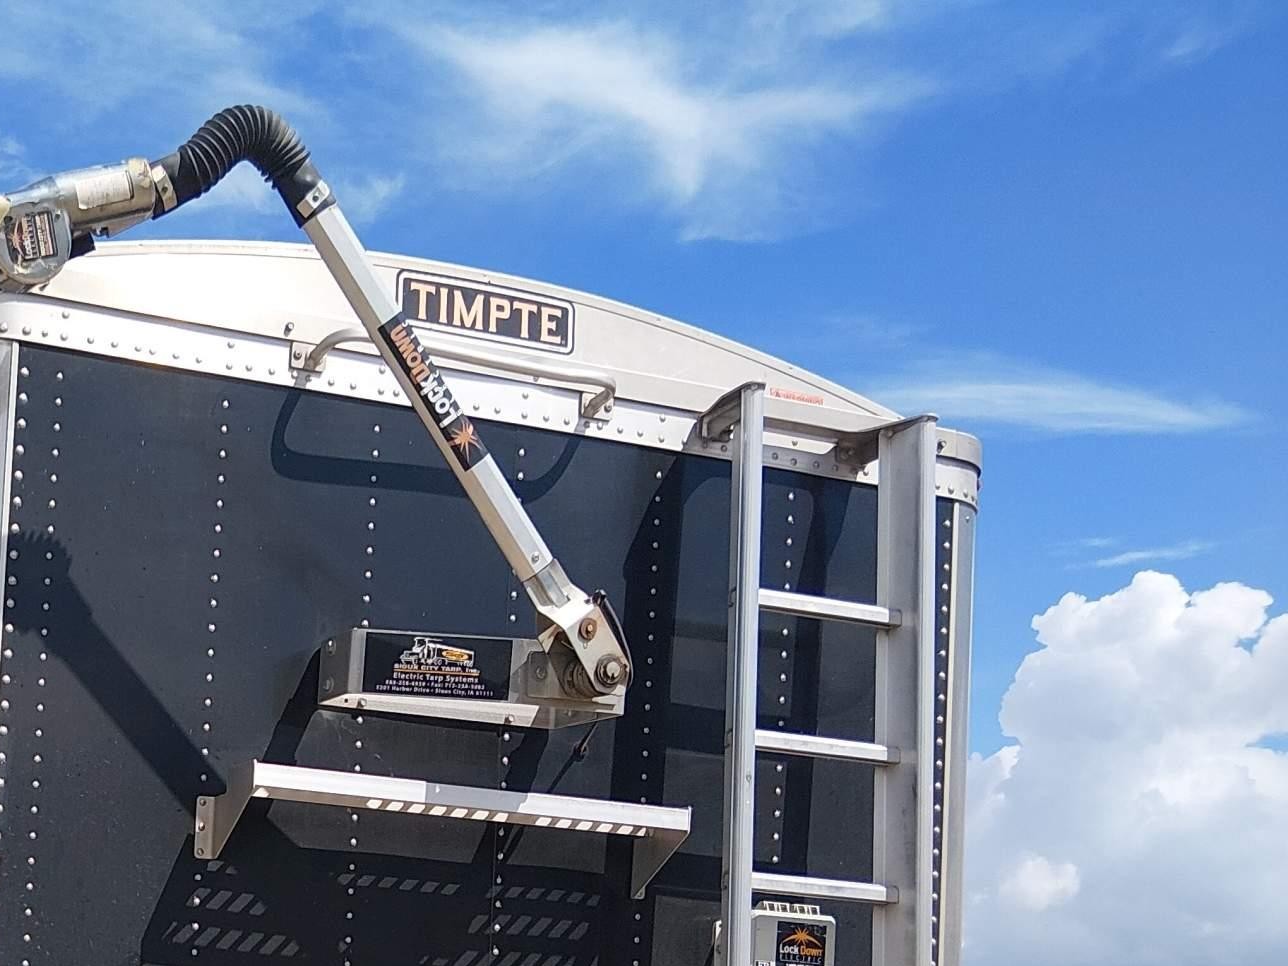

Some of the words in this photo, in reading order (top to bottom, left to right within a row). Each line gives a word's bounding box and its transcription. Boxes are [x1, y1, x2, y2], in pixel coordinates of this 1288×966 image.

[409, 281, 563, 344] TIMPTE
[393, 671, 423, 681] Electric
[779, 942, 799, 955] Lock
